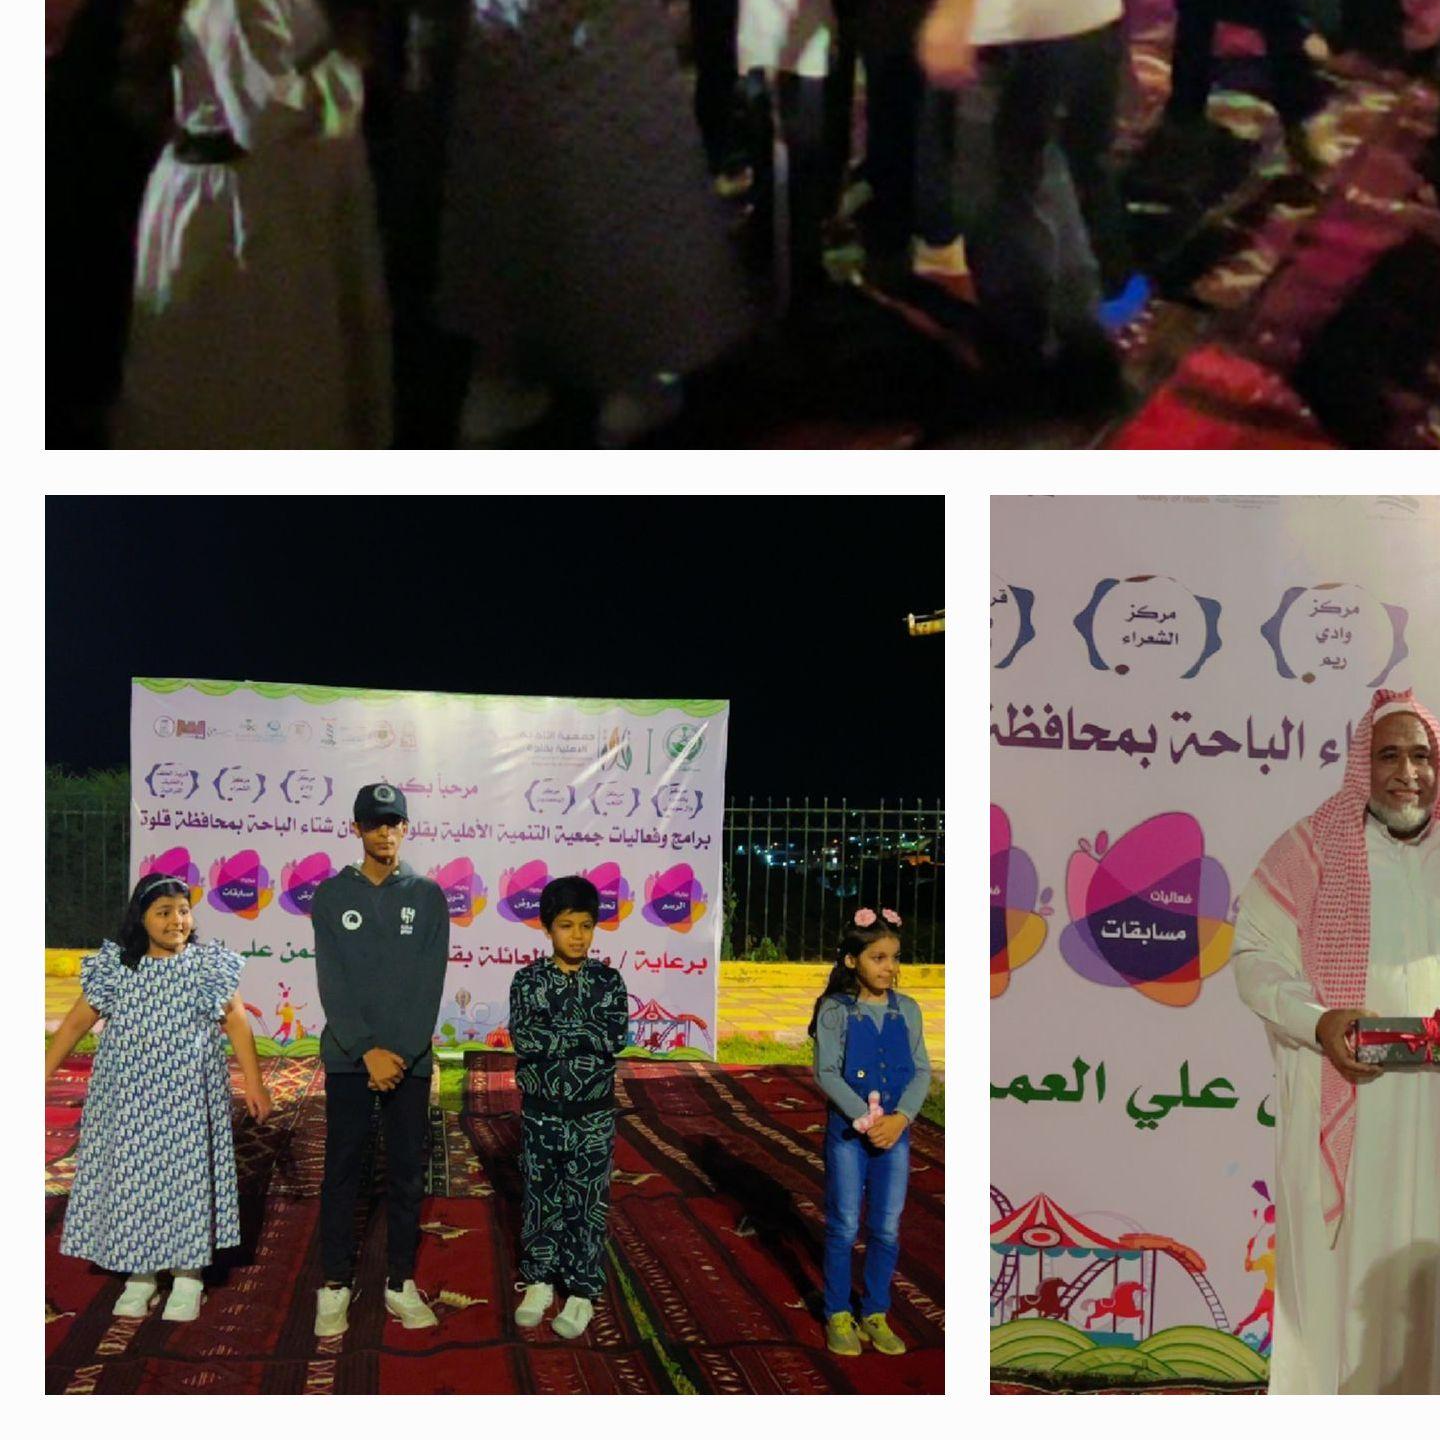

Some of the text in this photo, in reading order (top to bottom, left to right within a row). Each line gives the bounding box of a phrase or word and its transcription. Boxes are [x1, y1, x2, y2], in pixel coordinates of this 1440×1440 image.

[1124, 603, 1177, 624] مركز
[1308, 598, 1360, 620] مركز
[1121, 630, 1180, 647] الشعراء
[1314, 626, 1353, 645] وادي
[1318, 654, 1348, 670] ريم
[1169, 710, 1305, 775] الباحة
[139, 808, 172, 831] قلوة
[175, 809, 244, 836] بمحافظة
[247, 813, 297, 837] الباحة
[300, 814, 334, 838] شتاء
[440, 819, 493, 843] الأهلية
[497, 822, 551, 844] التنمية
[554, 825, 604, 846] جمعية
[608, 826, 668, 848] وفعاليات
[671, 827, 711, 850] برامج
[221, 886, 254, 899] مسابقات
[1149, 890, 1193, 905] فعاليات
[1100, 919, 1188, 945] مسابقات
[634, 951, 708, 976] برعاية
[1125, 1059, 1240, 1131] علي
